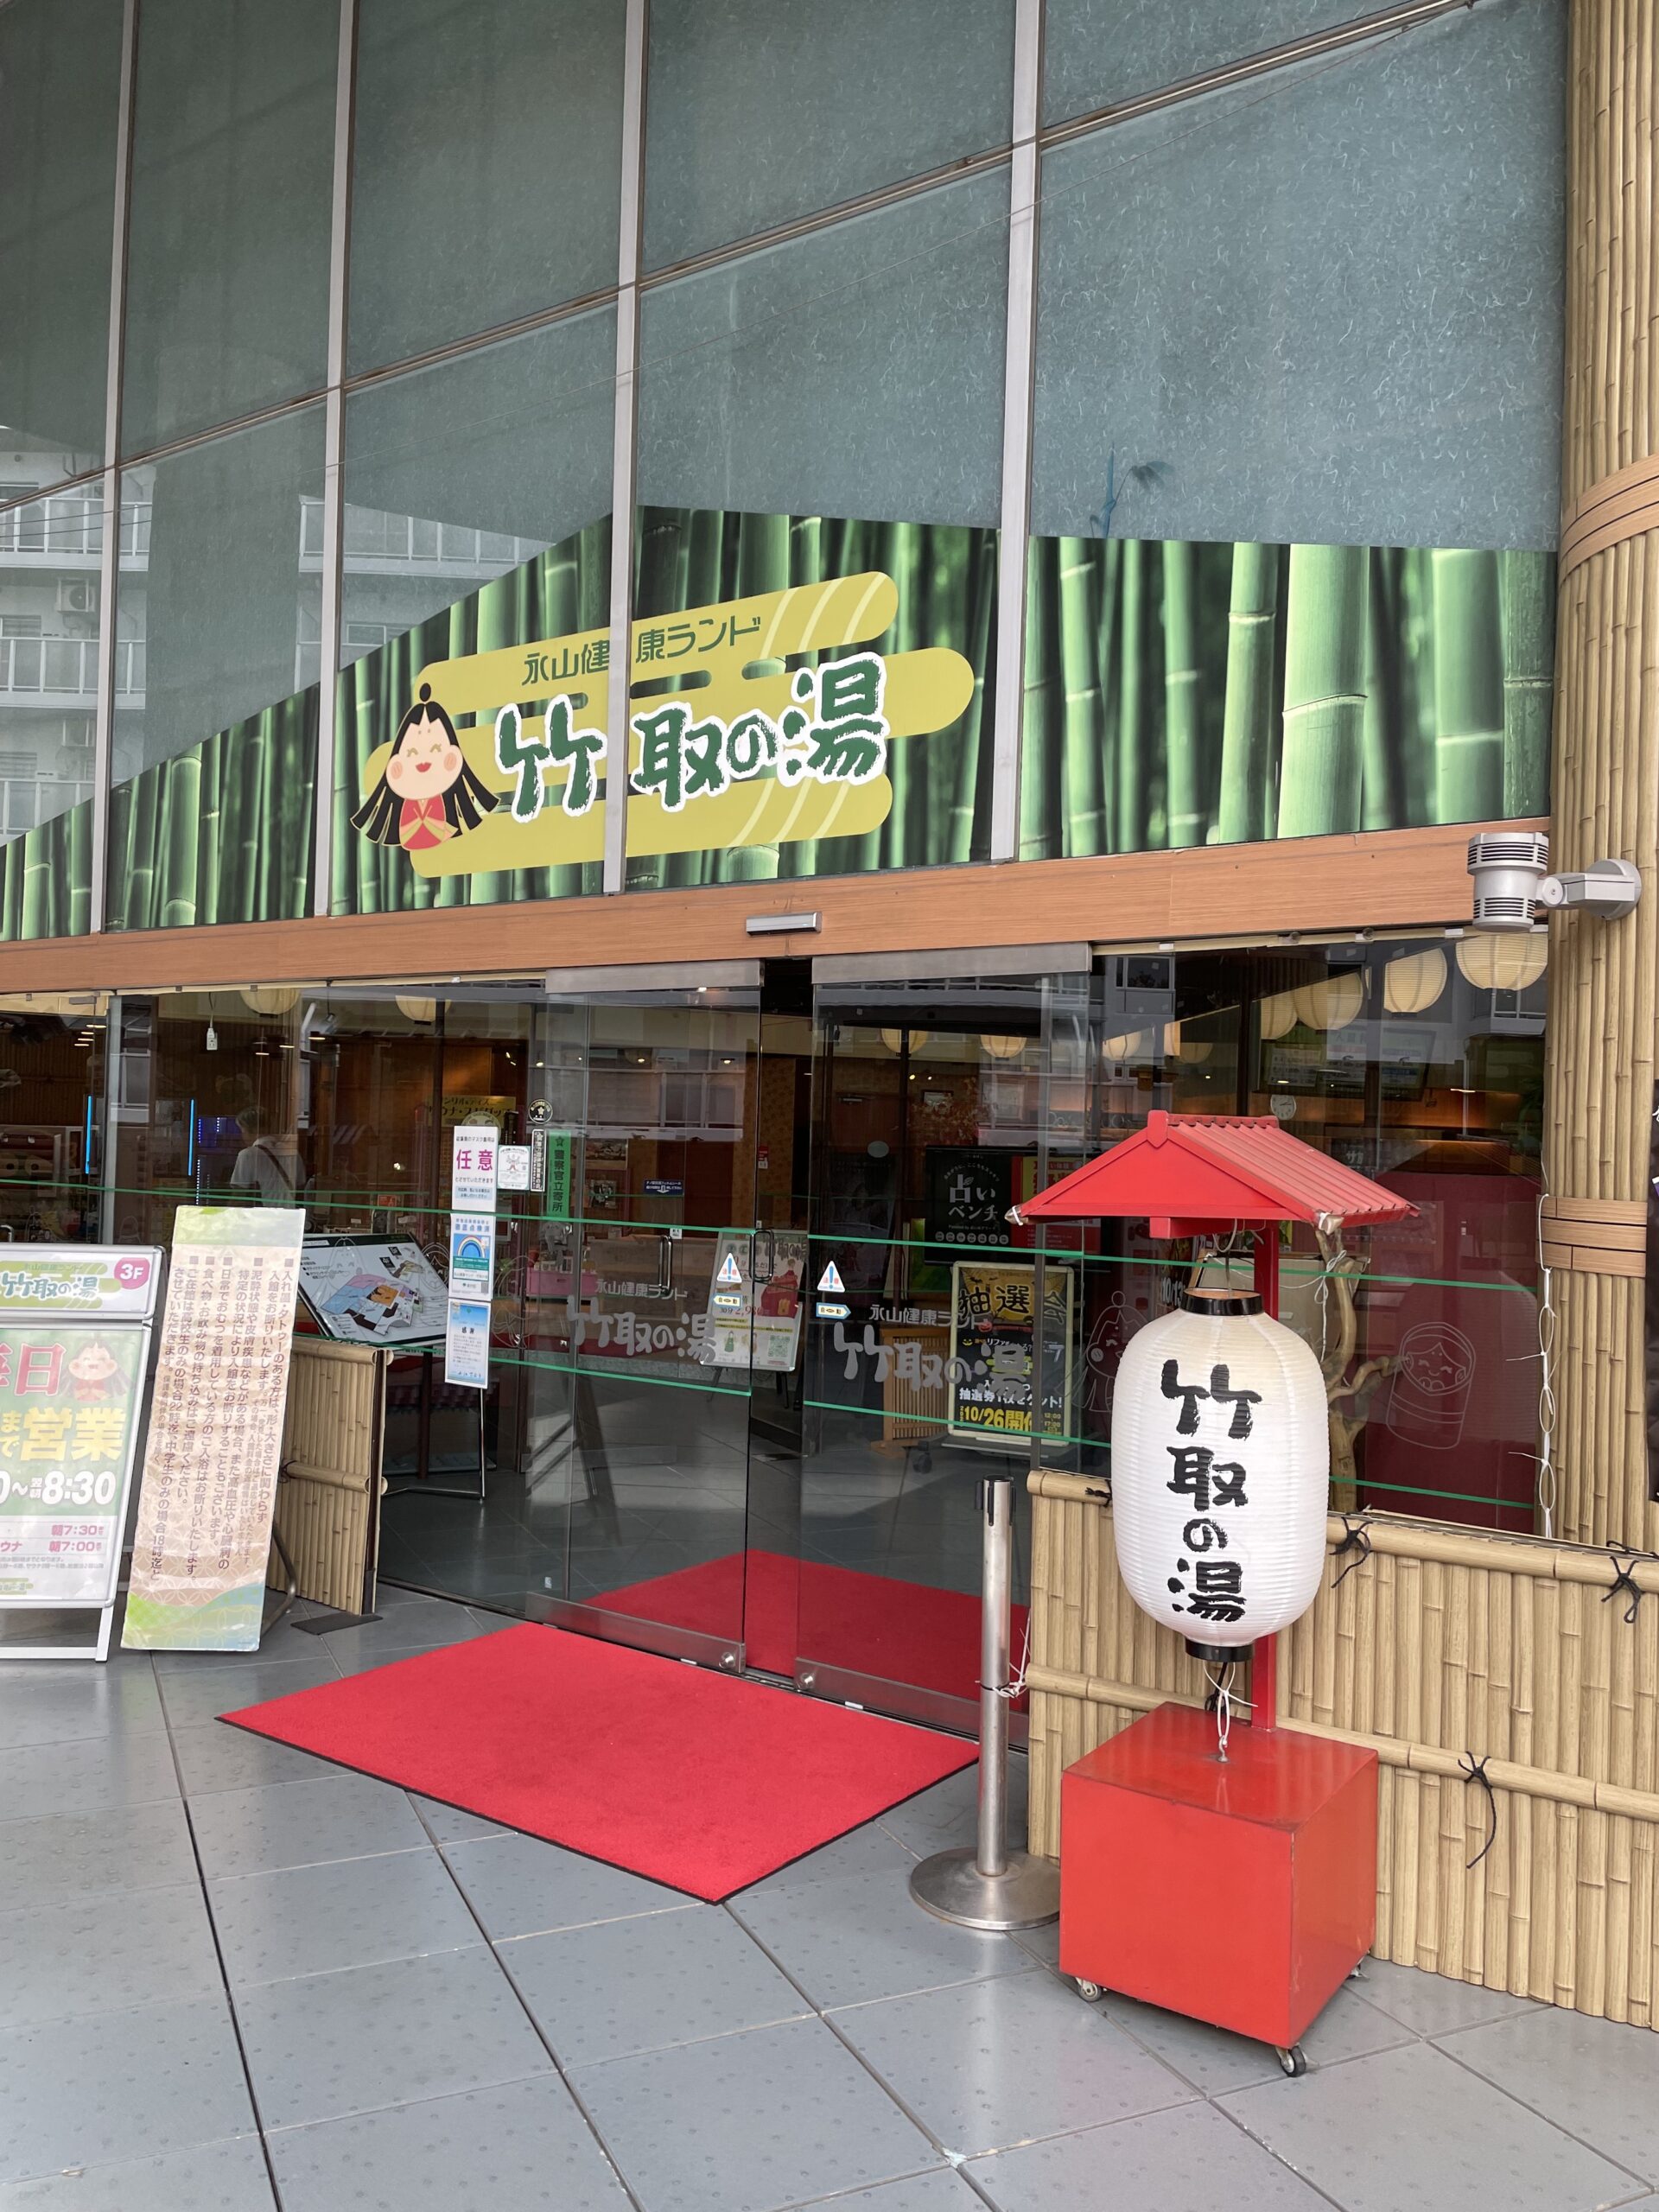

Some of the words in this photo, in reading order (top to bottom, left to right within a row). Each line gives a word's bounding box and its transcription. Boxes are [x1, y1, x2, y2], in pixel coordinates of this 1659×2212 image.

[521, 614, 761, 686] 永山健康ランド
[497, 656, 884, 819] 竹取の湯
[456, 1149, 493, 1171] 任意
[552, 1149, 565, 1212] 警察官立寄所
[949, 1173, 996, 1204] 占い
[948, 1205, 999, 1222] ベンチ
[2, 1272, 99, 1299] 竹取の湯
[120, 1263, 143, 1280] 3F
[566, 1295, 716, 1363] 竹取の湯
[834, 1321, 1028, 1402] 竹取の湯
[1160, 1358, 1262, 1623] 竹取の湯
